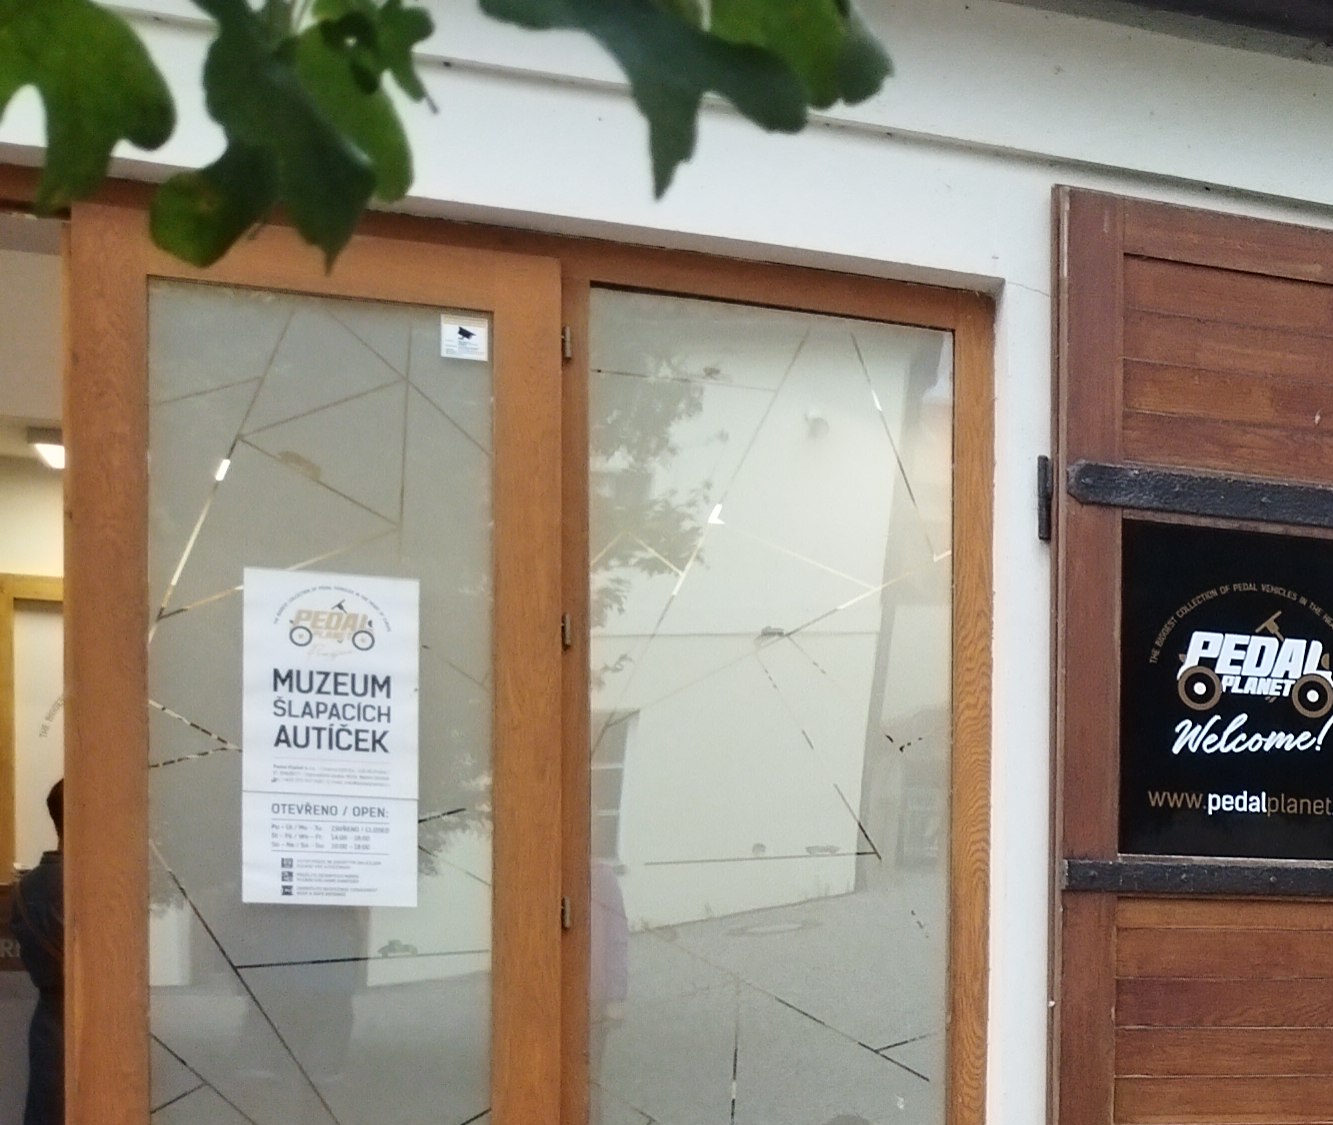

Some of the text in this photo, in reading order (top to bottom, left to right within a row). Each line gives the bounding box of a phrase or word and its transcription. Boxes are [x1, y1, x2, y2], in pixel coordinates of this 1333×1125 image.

[292, 608, 373, 633] PEDAL
[1149, 648, 1160, 664] THE
[1175, 588, 1218, 618] COLLECTION
[1219, 585, 1230, 595] OF
[1232, 582, 1258, 592] PEDAL
[1261, 583, 1298, 601] VEHICLES
[1309, 601, 1323, 616] THE
[273, 668, 391, 699] MUZEUM
[1220, 675, 1299, 698] PLANET
[273, 696, 391, 723] ŠLAPACÍCH
[274, 723, 390, 753] AUTÍČEK
[271, 802, 338, 817] OTEVŘENO
[352, 806, 389, 818] OPEN:
